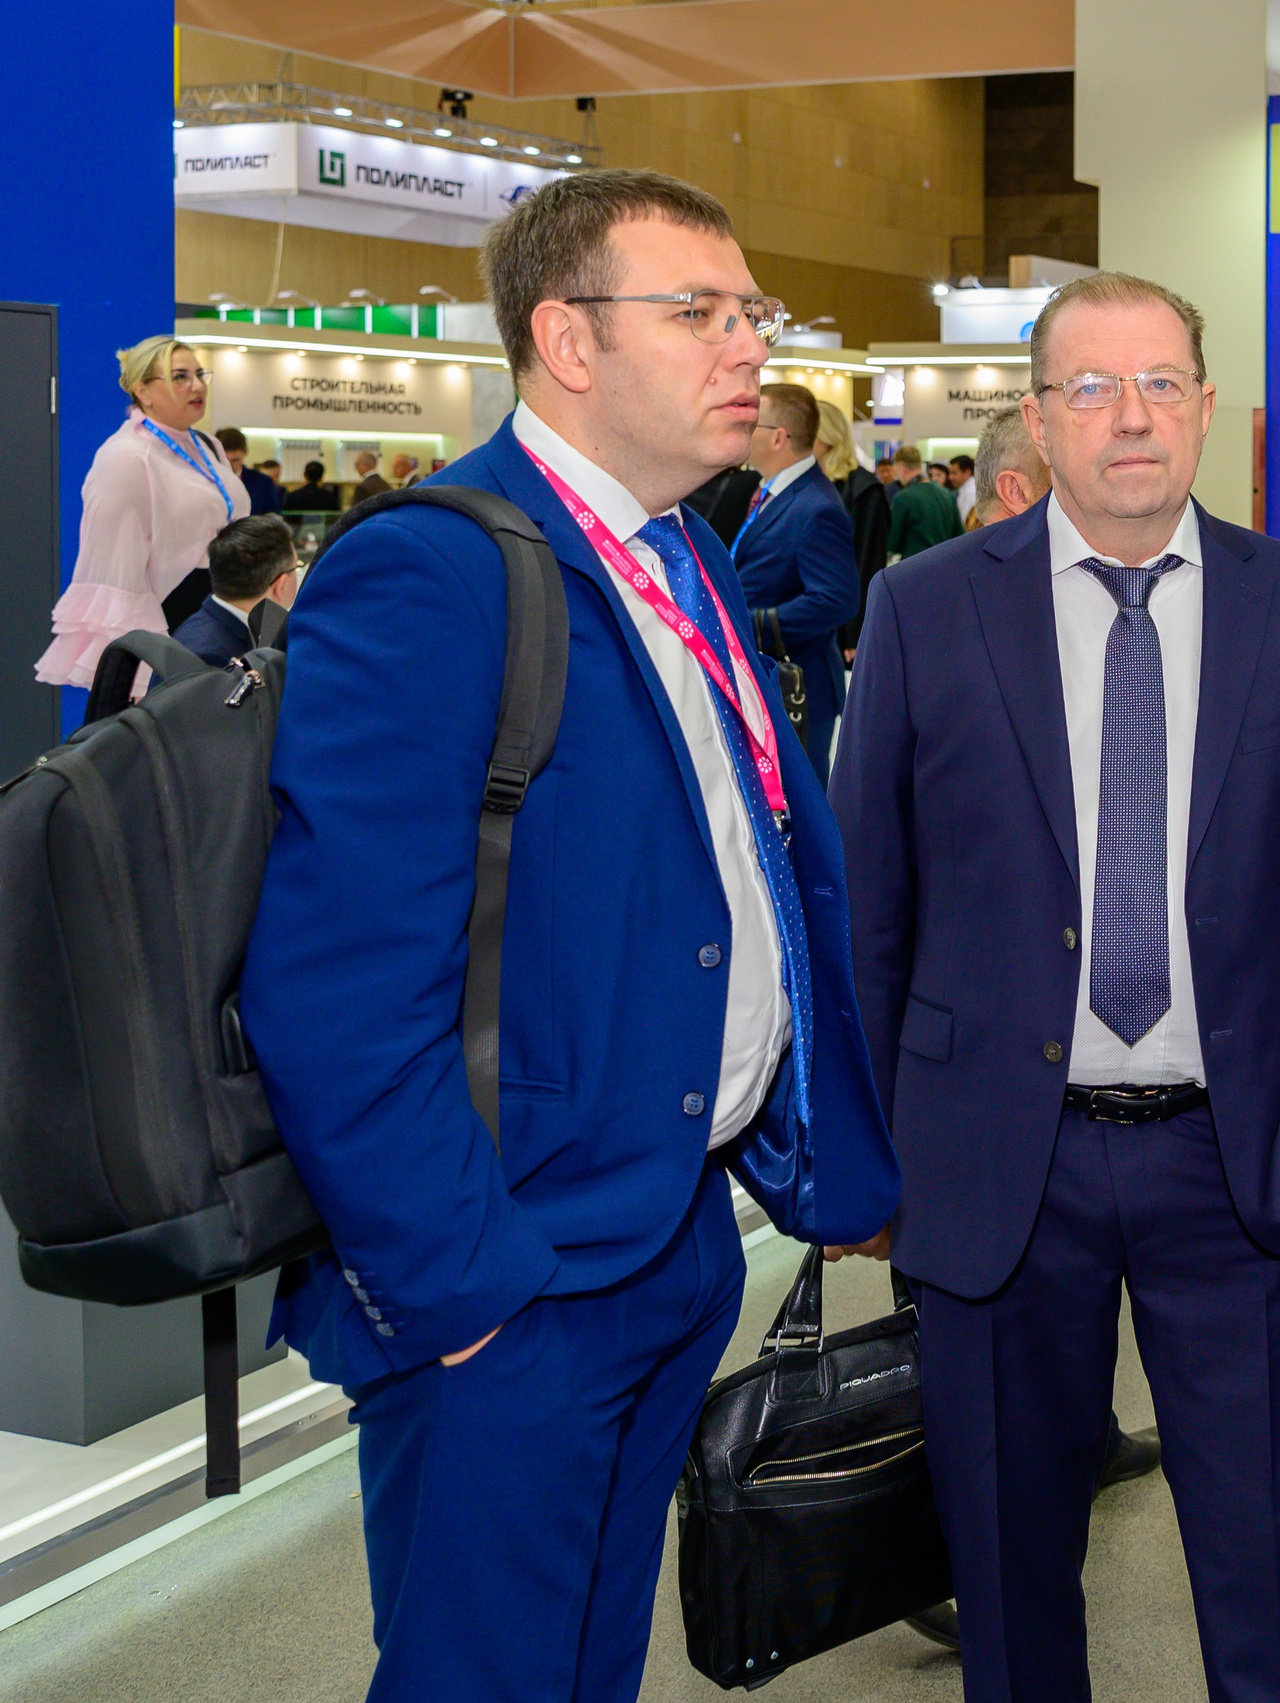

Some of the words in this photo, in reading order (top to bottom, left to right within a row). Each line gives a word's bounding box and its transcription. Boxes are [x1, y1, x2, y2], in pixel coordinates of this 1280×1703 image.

[185, 154, 270, 172] ПОЛИПЛАСТ
[356, 164, 465, 200] ПОЛИПЛАСТ
[291, 377, 406, 396] СТРОИТЕЛЬНАЯ
[948, 389, 1025, 402] МАШИНО
[272, 395, 423, 416] ПРОМЫШЛЕННОСТЬ
[963, 407, 997, 420] ПРО
[840, 1364, 911, 1391] PIQUADRO
